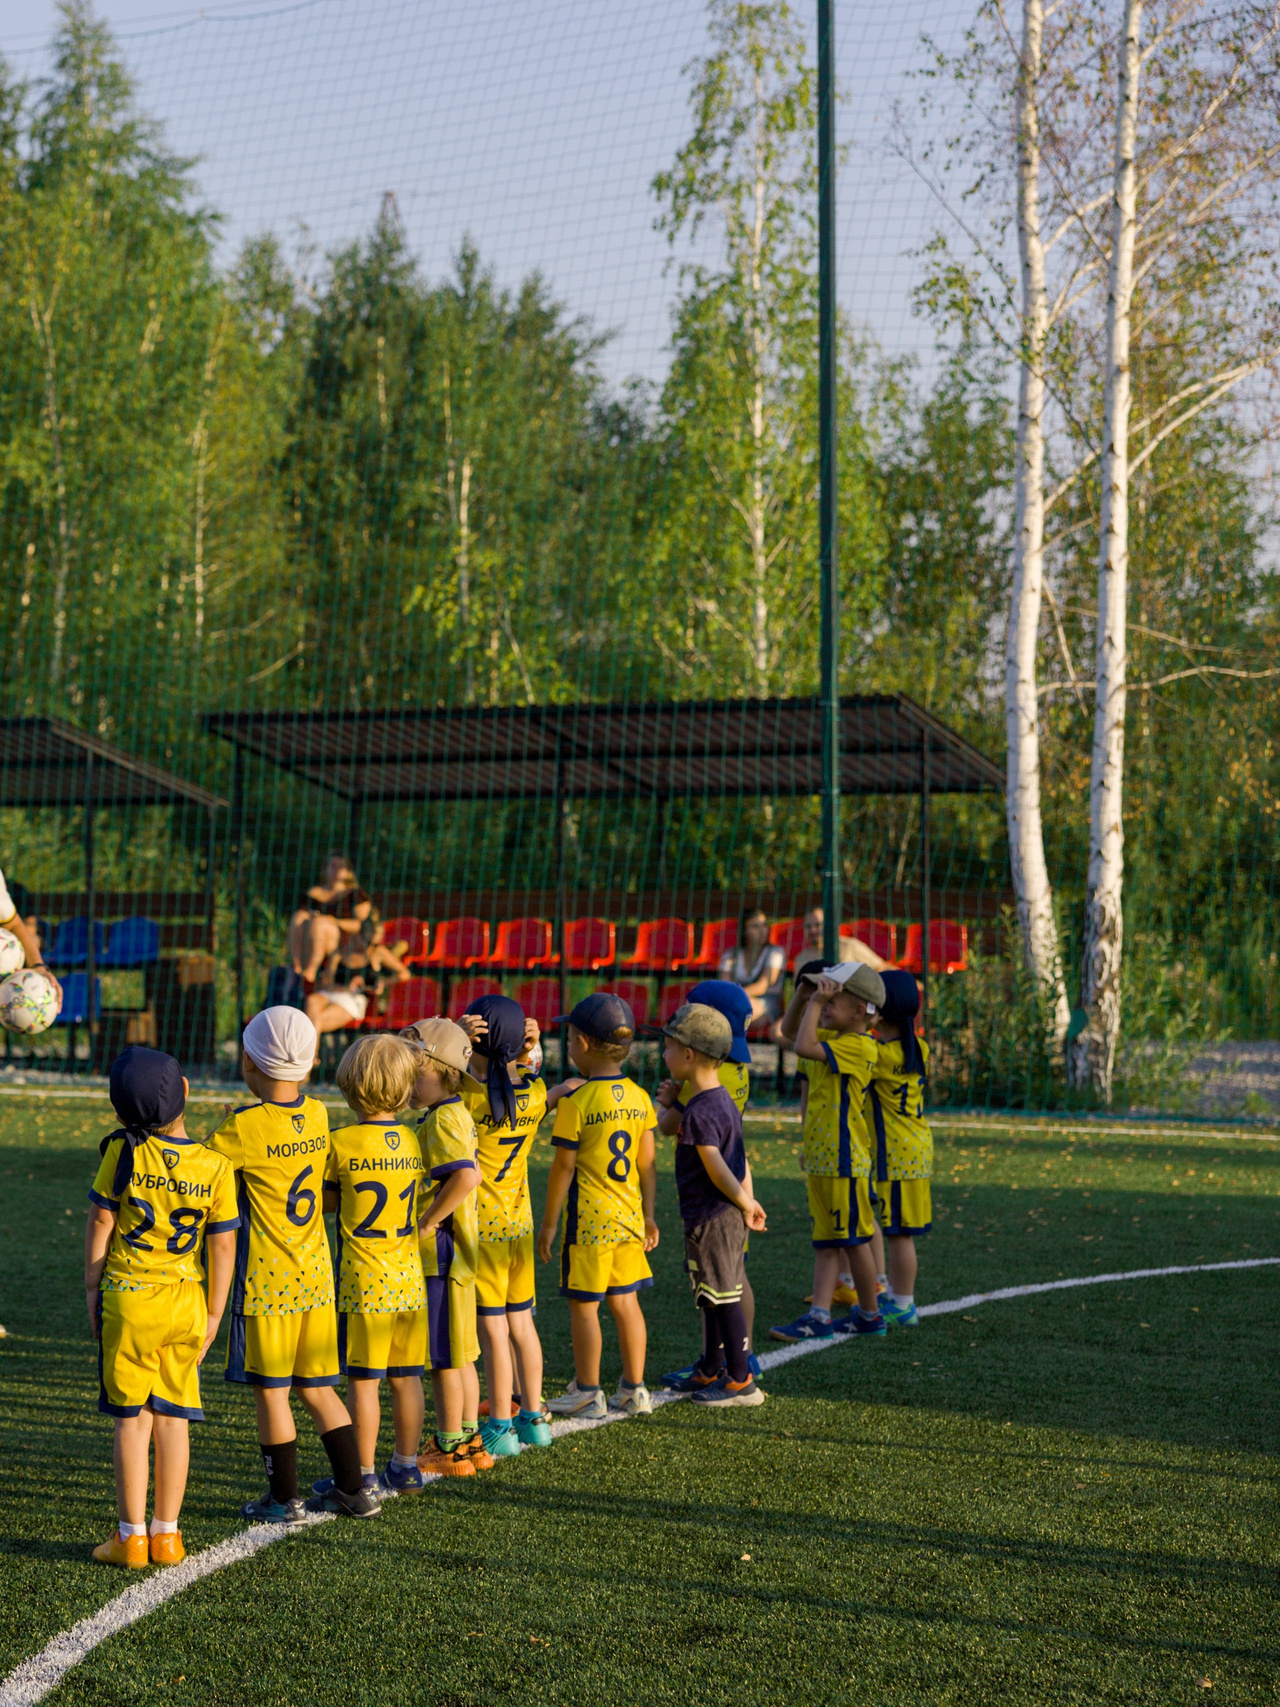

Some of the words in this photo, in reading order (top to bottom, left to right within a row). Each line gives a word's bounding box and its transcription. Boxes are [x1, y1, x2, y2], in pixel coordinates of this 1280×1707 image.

[266, 1135, 326, 1158] МОРОЗОВ
[494, 1134, 528, 1182] 7
[606, 1129, 632, 1182] 8
[286, 1164, 317, 1227] 6
[352, 1179, 417, 1239] 21
[121, 1196, 205, 1256] 28
[264, 1455, 274, 1476] FILA
